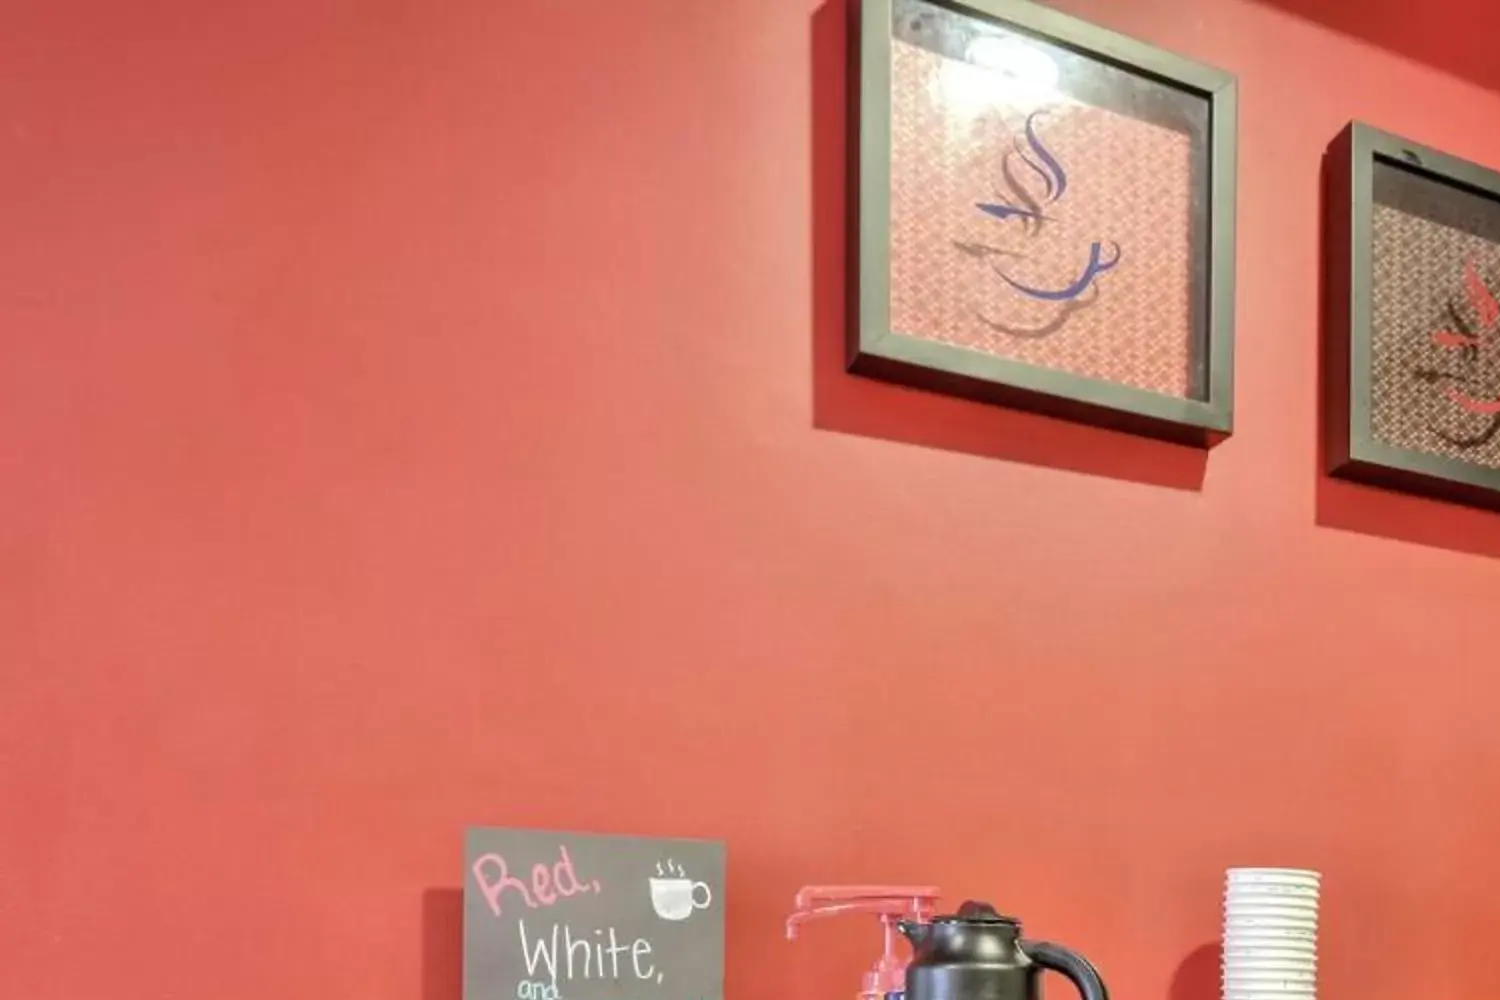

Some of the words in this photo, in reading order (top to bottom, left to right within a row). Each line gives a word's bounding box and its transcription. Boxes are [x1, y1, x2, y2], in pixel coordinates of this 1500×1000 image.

[473, 845, 600, 916] Red,
[519, 919, 664, 984] White,
[518, 979, 562, 1000] and
